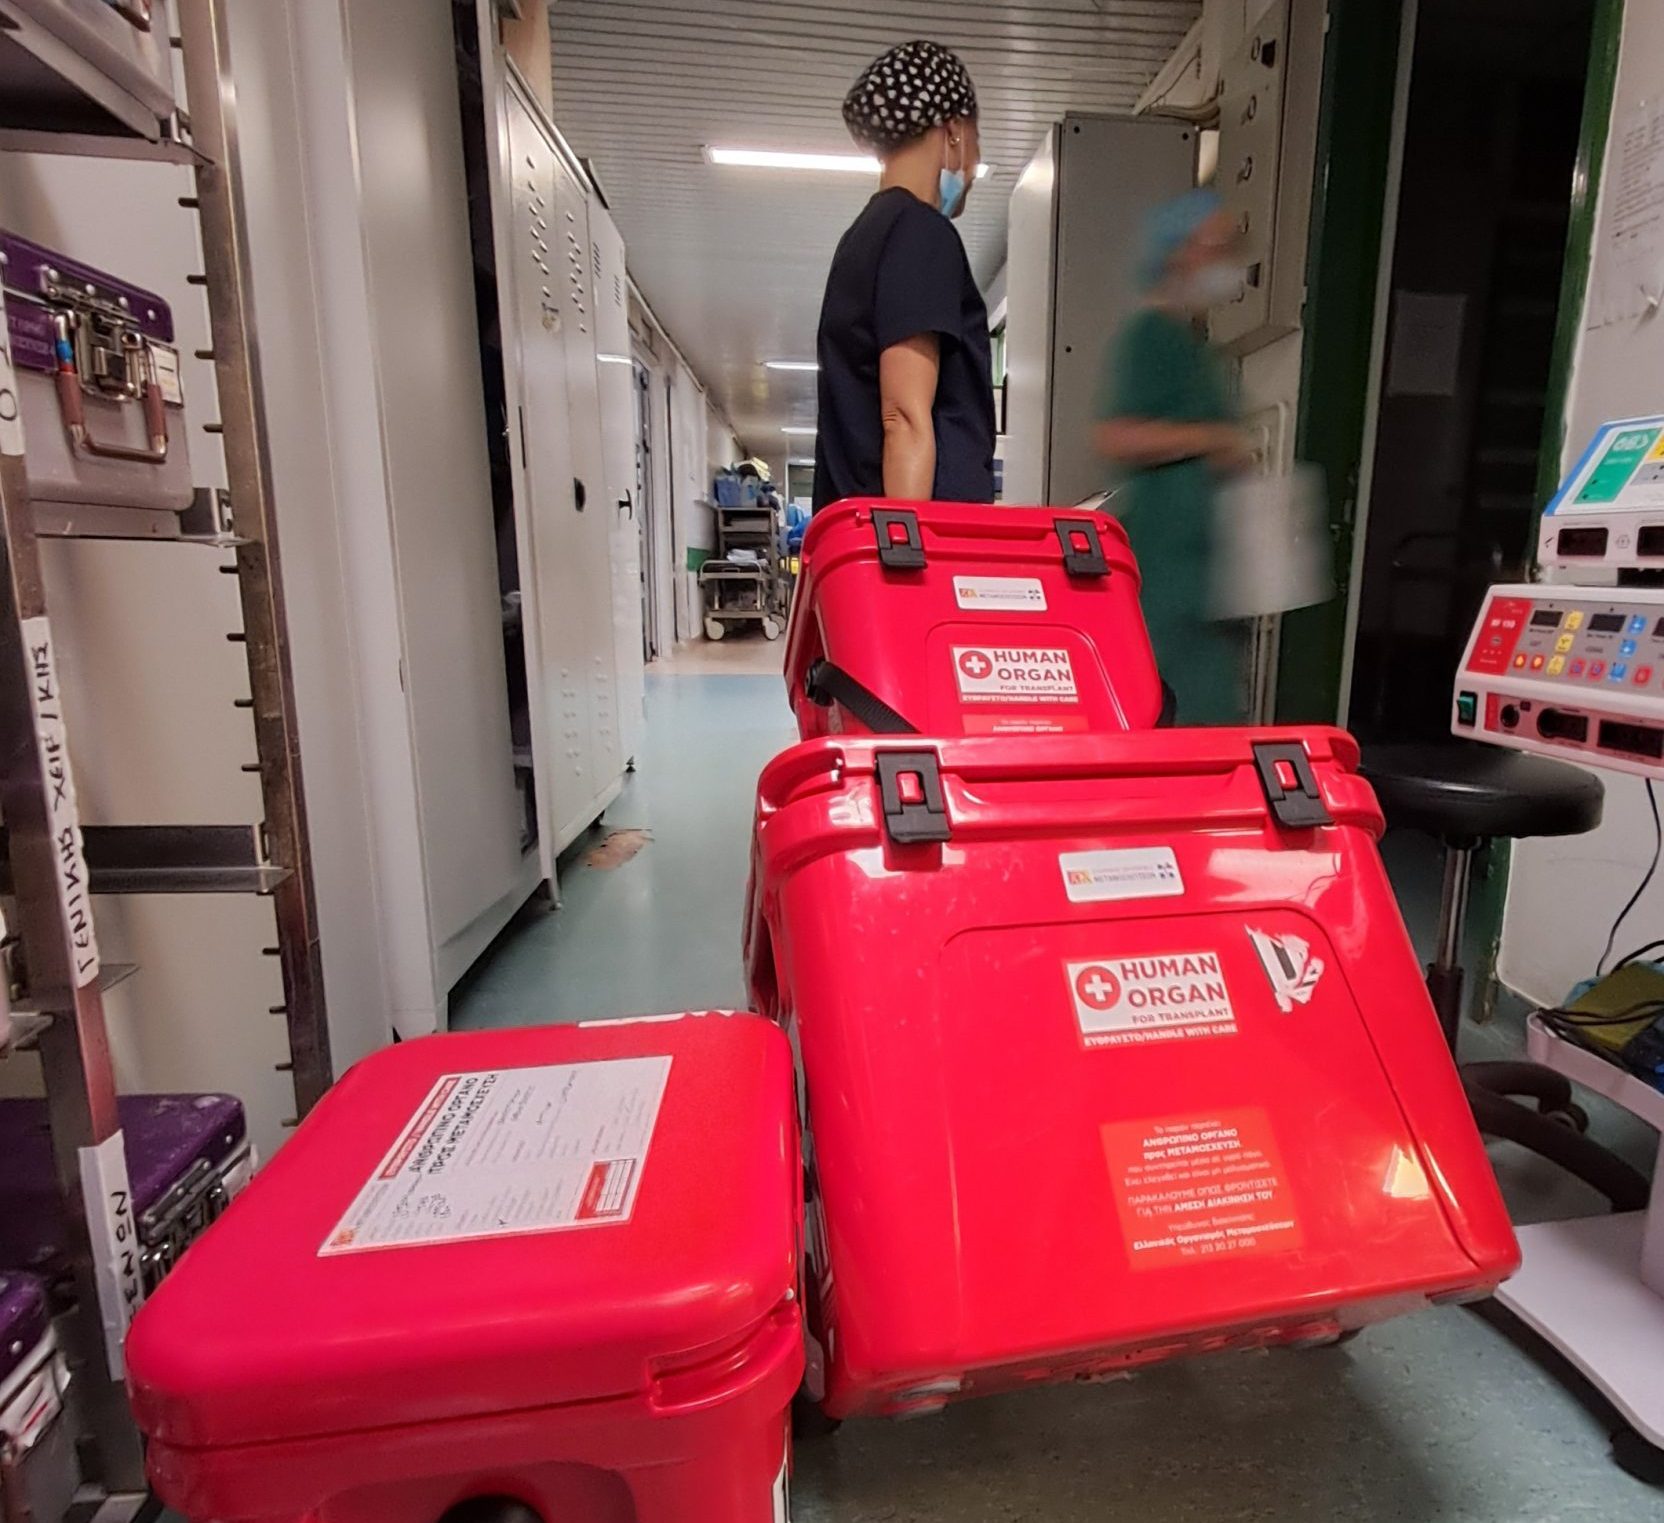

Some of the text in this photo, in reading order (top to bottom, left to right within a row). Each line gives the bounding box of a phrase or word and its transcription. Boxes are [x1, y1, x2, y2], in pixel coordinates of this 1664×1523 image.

[993, 650, 1067, 663] HUMAN
[998, 668, 1072, 681] ORGAN
[1120, 955, 1218, 980] HUMAN
[1128, 982, 1225, 1007] ORGAN
[1132, 1008, 1229, 1024] FOR TRANSPLANT
[1185, 1026, 1212, 1038] WITH
[1212, 1023, 1238, 1034] CARE
[409, 1112, 456, 1173] ΑΝΘΡΩΠΙΝΟ
[447, 1077, 478, 1112] ΟΡΓΑΝΟ
[1143, 1128, 1238, 1148] ΑΝΘΡΩΠΙΝΟ ΟΡΓΑΝΟ
[1256, 1190, 1273, 1201] ΤΟΥ
